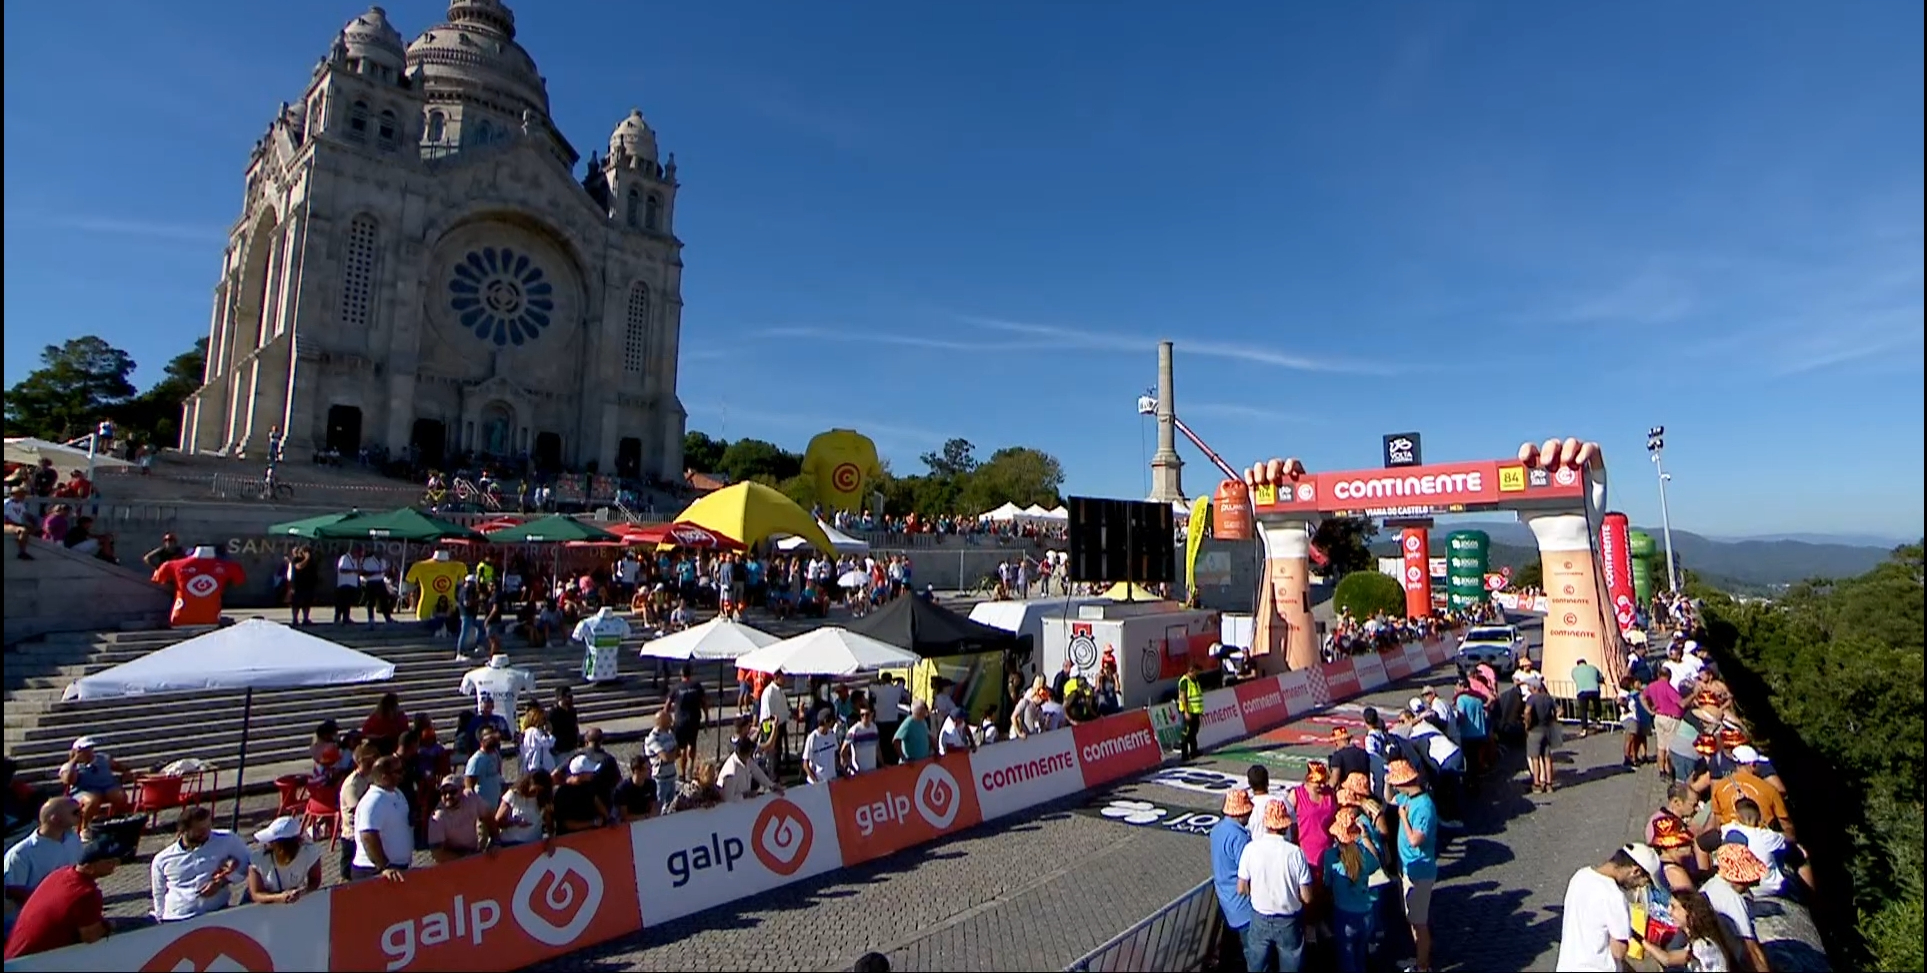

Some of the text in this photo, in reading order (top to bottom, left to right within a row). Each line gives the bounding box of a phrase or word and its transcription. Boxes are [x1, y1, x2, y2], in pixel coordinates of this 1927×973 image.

[1334, 472, 1482, 499] CONTINENTE
[1504, 472, 1518, 483] 84
[1365, 507, 1387, 517] VIANA
[1387, 506, 1396, 516] DO
[1398, 505, 1429, 516] CASTELO
[1601, 524, 1614, 588] CONTINENTE
[1407, 582, 1422, 591] galp
[1550, 629, 1595, 638] CONTINENTE
[1243, 692, 1282, 713] CONTINENTE
[1283, 684, 1308, 698] NTINENTE
[1200, 704, 1238, 727] NTINENTE
[1082, 728, 1151, 762] CONTINENTE
[982, 751, 1074, 791] CONTINENTE
[855, 792, 911, 836] galp
[1162, 812, 1220, 826] JO
[667, 833, 744, 887] galp
[381, 894, 501, 971] galp
